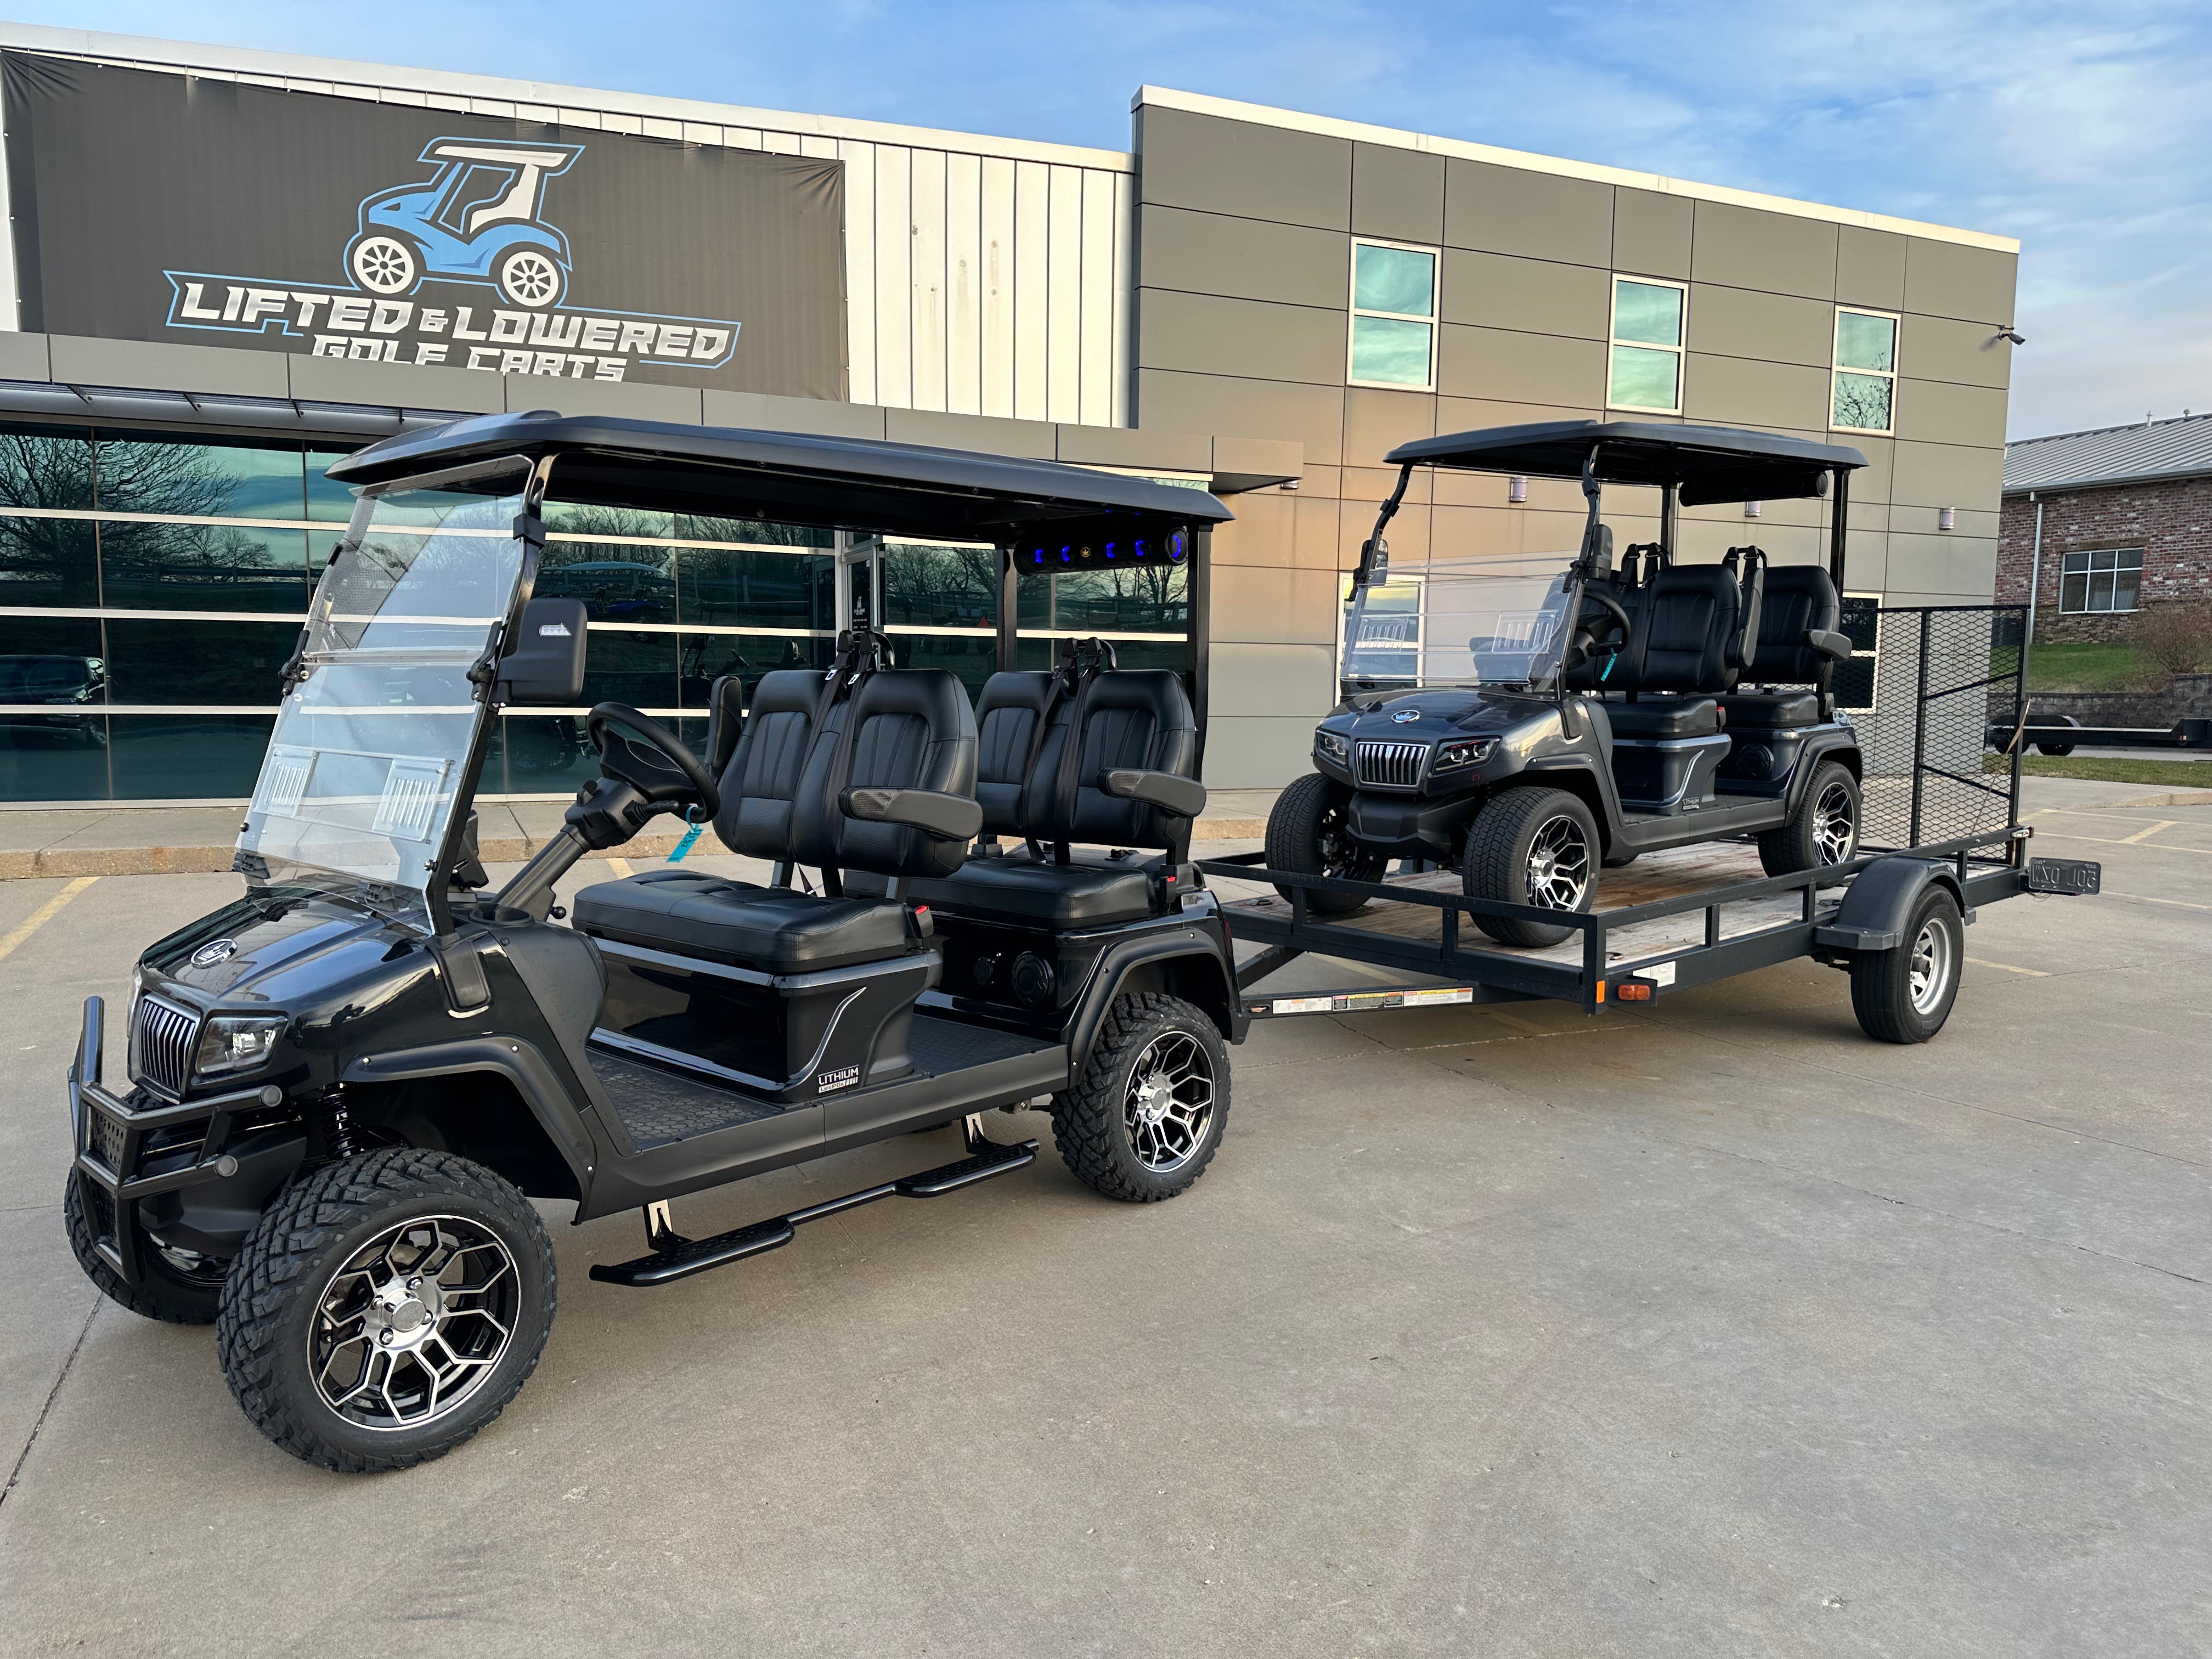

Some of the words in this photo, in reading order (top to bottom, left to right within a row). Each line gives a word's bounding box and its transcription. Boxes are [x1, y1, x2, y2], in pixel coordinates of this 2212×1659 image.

[180, 282, 414, 333] LIFTED
[419, 308, 449, 332] &
[452, 306, 730, 359] LOWERED
[312, 334, 449, 365] GOLF
[466, 346, 628, 382] CARTS
[819, 1067, 859, 1085] LITHIUM
